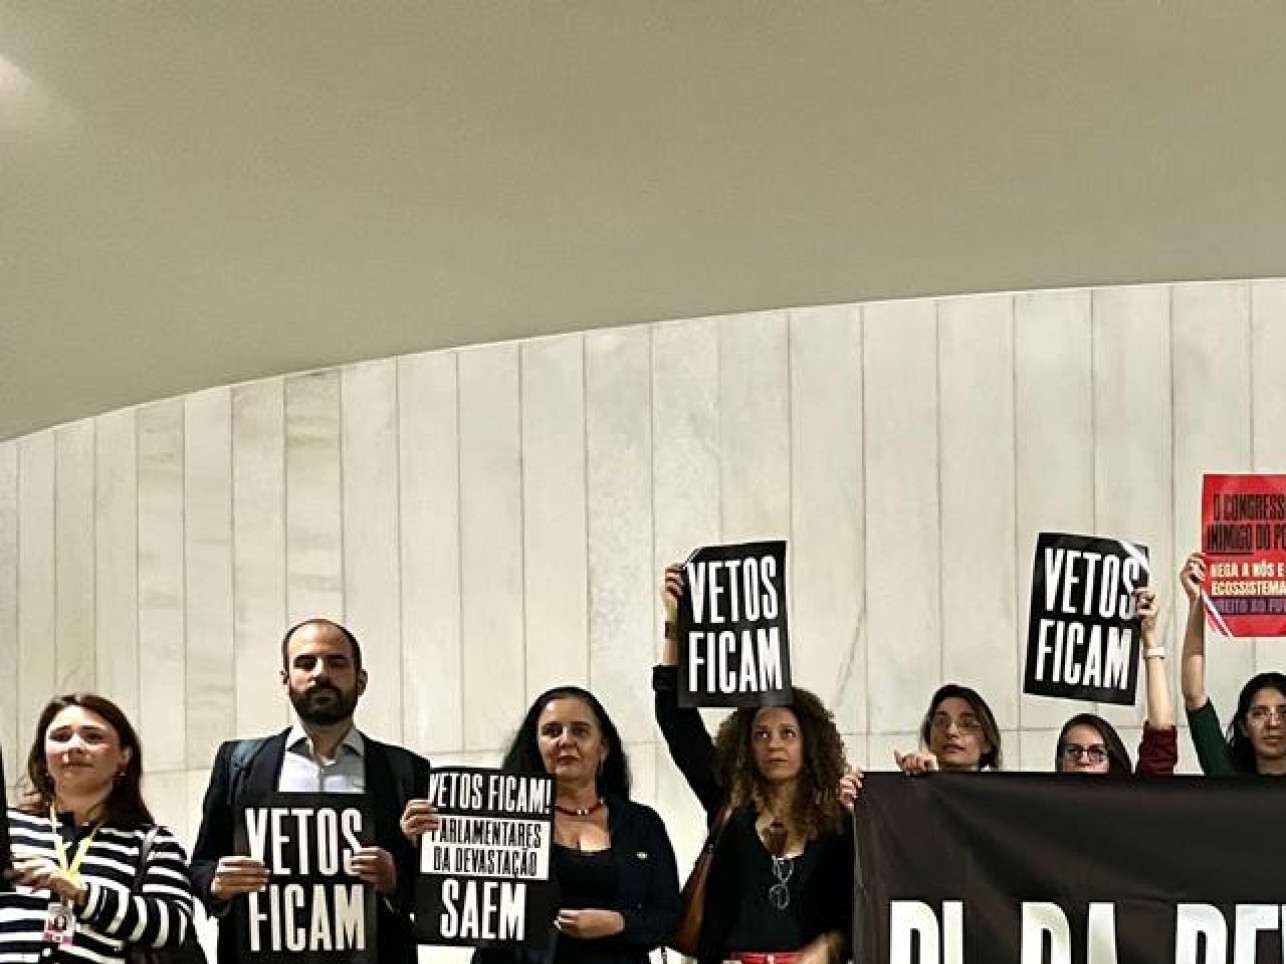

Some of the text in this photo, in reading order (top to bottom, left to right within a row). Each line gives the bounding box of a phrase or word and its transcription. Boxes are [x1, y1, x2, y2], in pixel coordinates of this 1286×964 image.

[1209, 524, 1253, 551] INIMIGO
[1256, 524, 1271, 550] DO
[1211, 562, 1239, 577] NEGA
[1242, 562, 1249, 577] A
[1278, 562, 1284, 577] E
[687, 556, 779, 624] VETOS
[1044, 548, 1140, 620] VETOS
[688, 627, 783, 694] FICAM
[1035, 618, 1132, 690] FICAM
[429, 772, 552, 815] VETOS FICAM!
[245, 807, 363, 875] VETOS
[434, 846, 450, 871] DA
[249, 883, 365, 952] FICAM
[440, 879, 526, 941] SAEM
